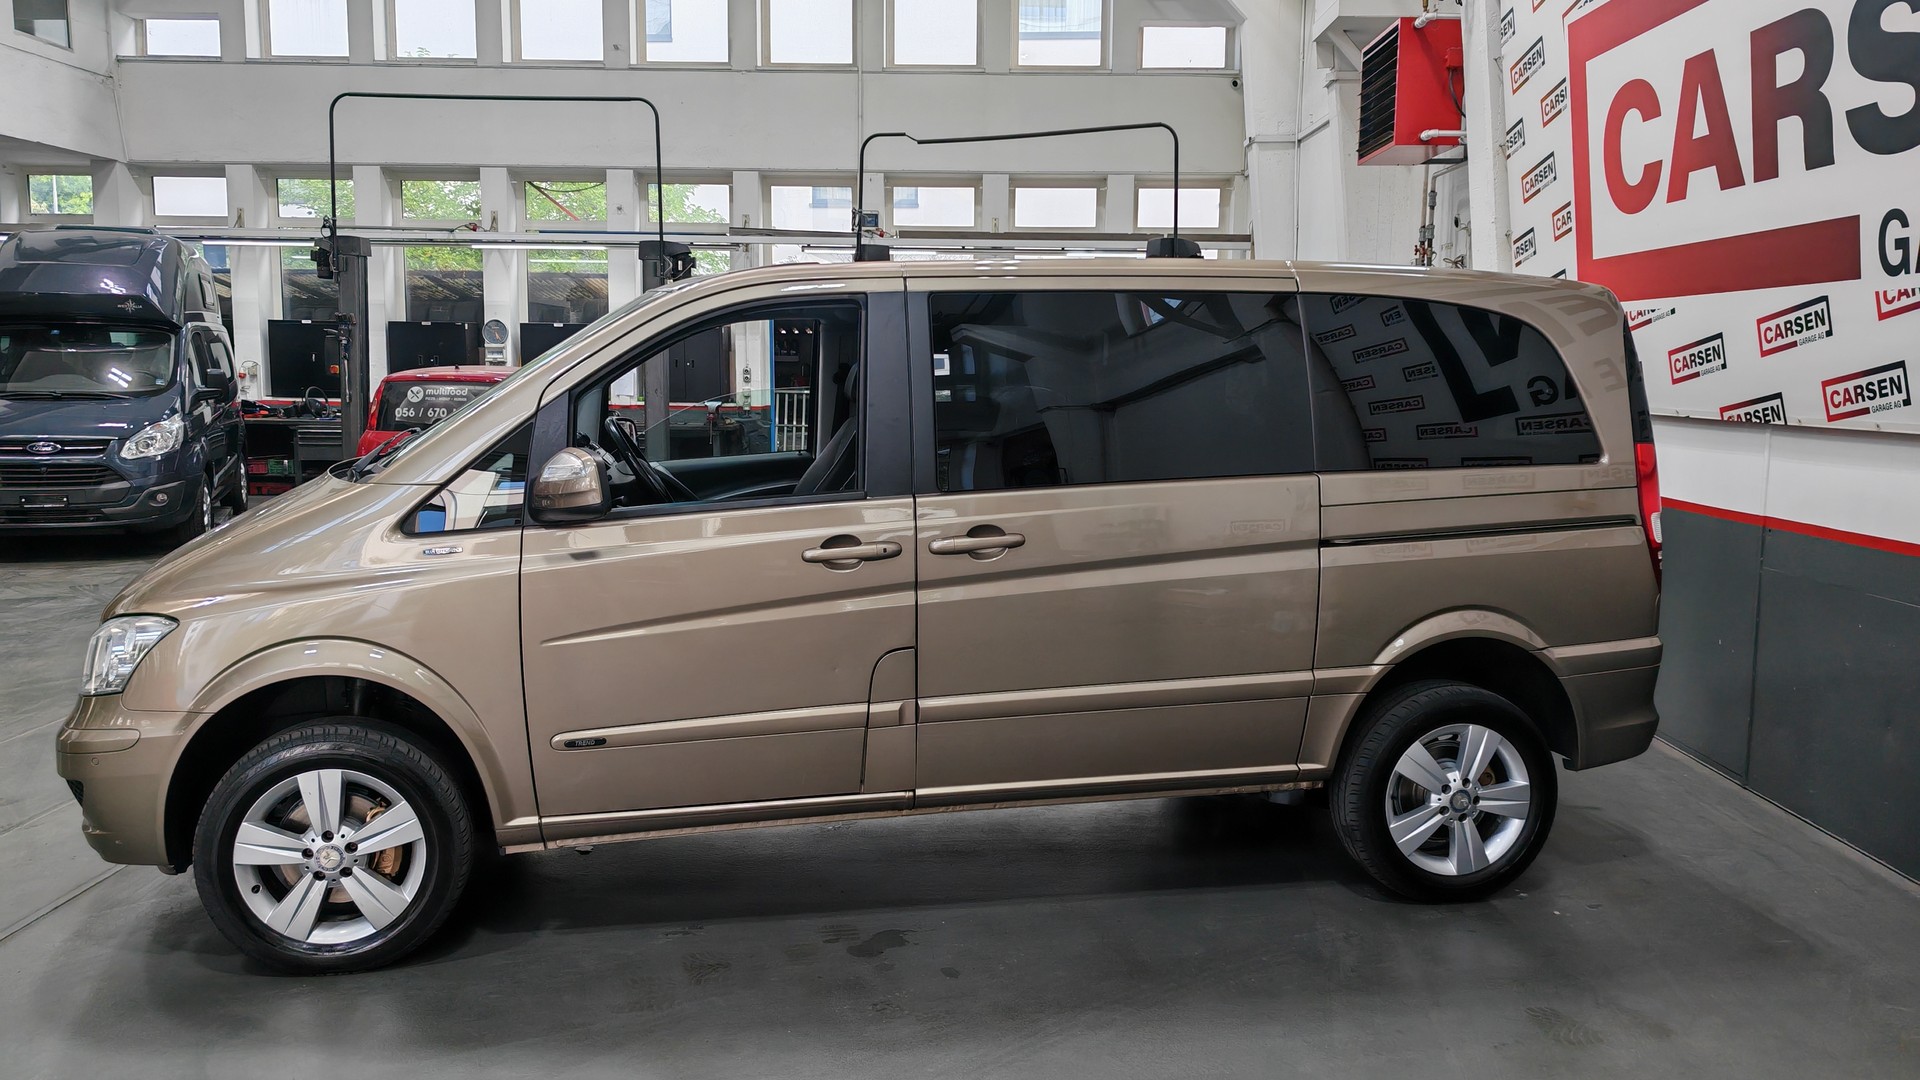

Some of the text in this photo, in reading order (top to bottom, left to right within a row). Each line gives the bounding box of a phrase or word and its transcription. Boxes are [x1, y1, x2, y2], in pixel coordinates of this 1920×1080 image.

[1513, 46, 1542, 84] CARSEN
[1603, 0, 1920, 214] CARS
[1524, 161, 1554, 194] CARSEN
[1514, 236, 1534, 260] RSEN
[1878, 207, 1920, 277] G
[1763, 308, 1826, 344] CARSEN
[1798, 331, 1824, 346] GARAGE AG
[1673, 344, 1721, 373] CARSEN
[1829, 374, 1903, 409] CARSEN
[1871, 399, 1902, 414] GARAGE AG
[395, 408, 415, 418] 056
[427, 408, 447, 418] 670
